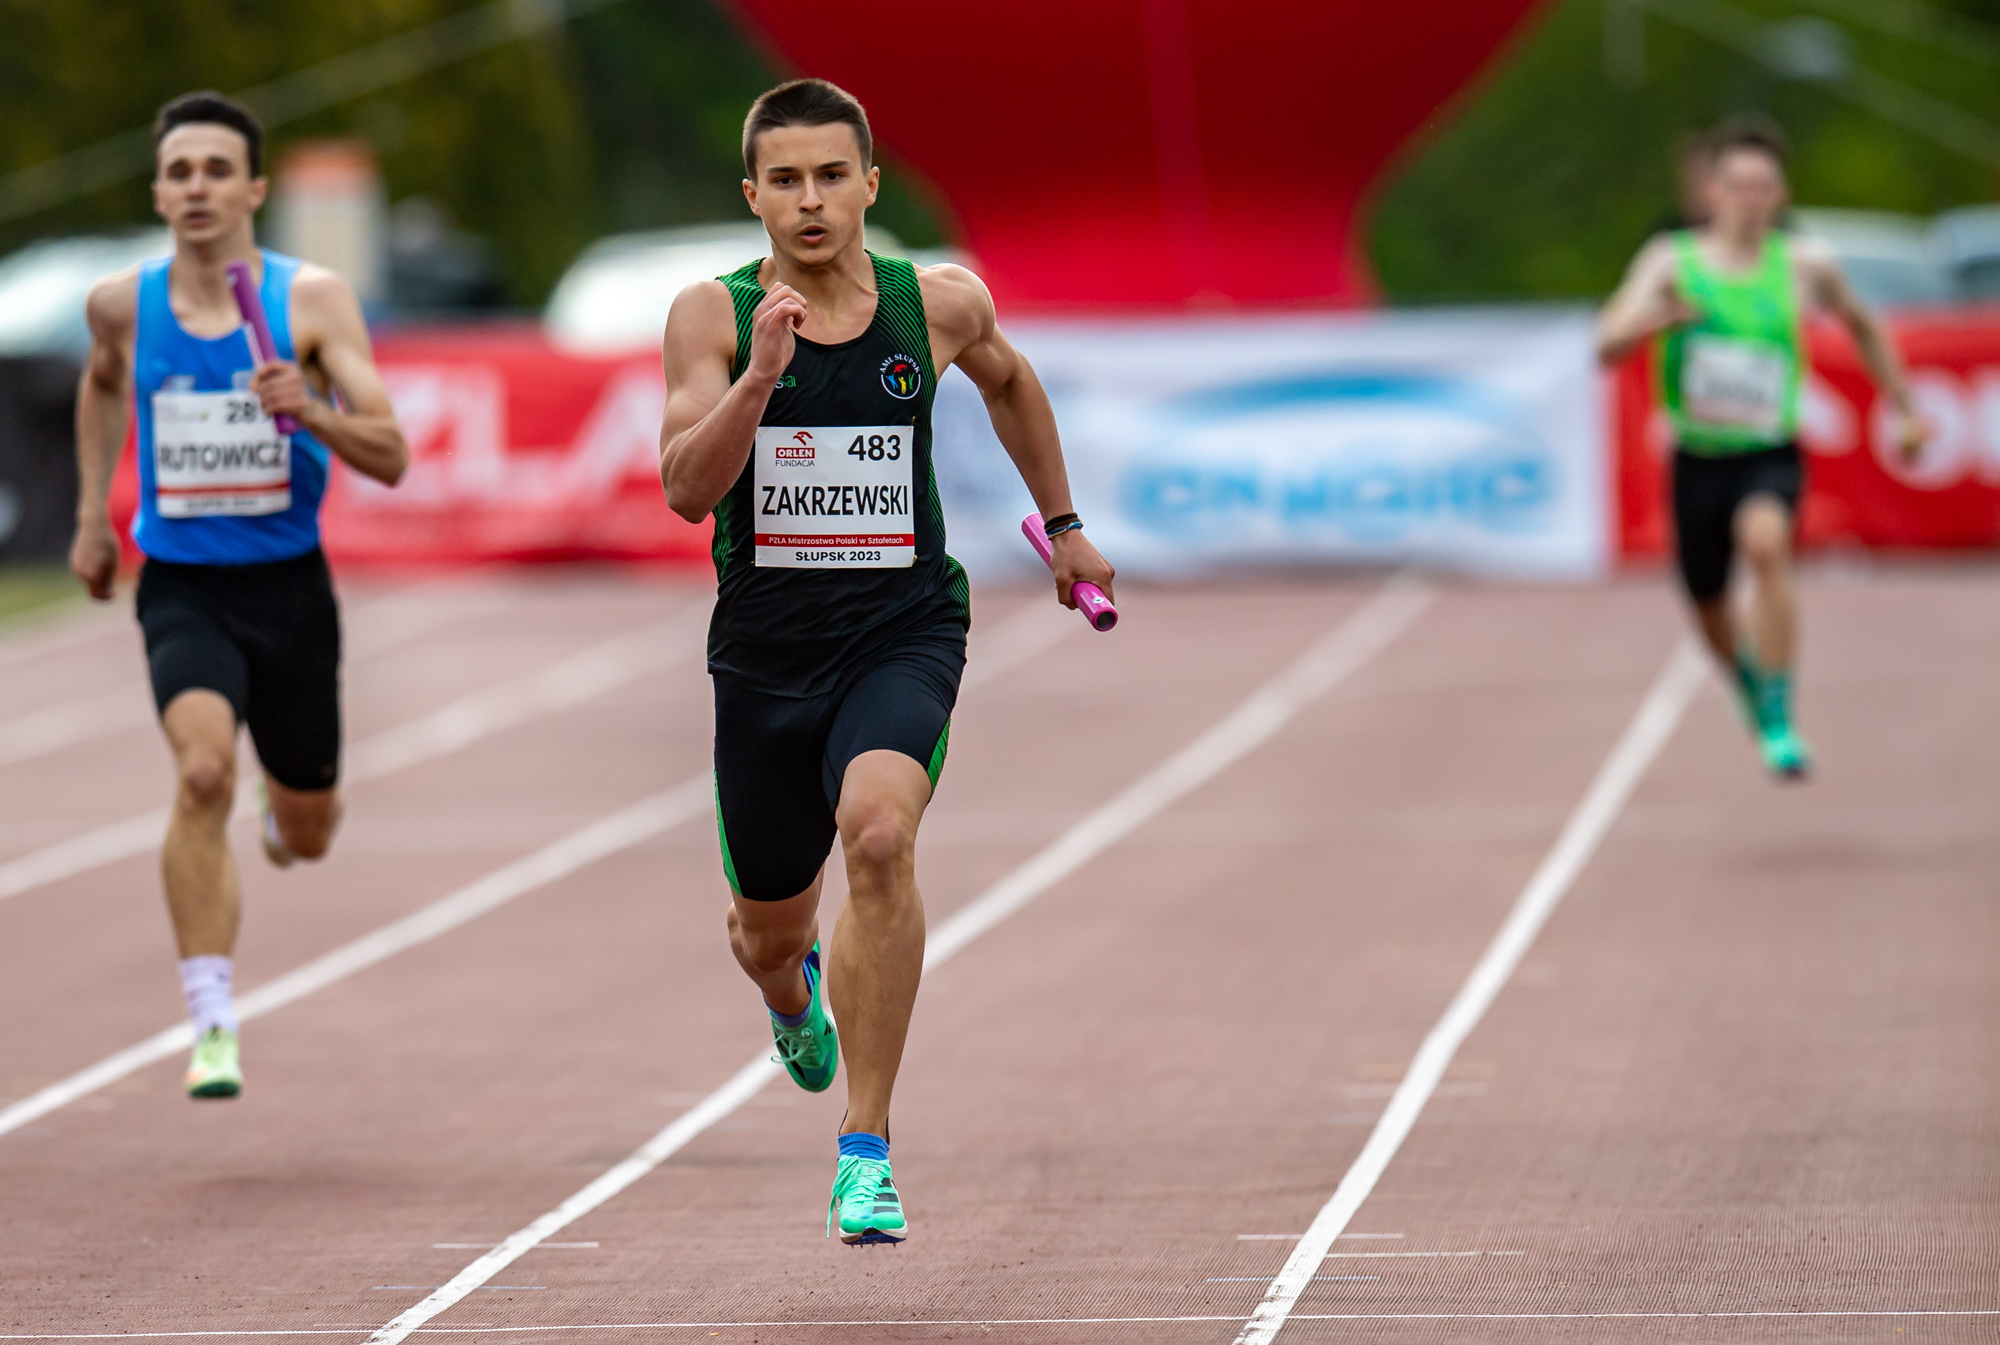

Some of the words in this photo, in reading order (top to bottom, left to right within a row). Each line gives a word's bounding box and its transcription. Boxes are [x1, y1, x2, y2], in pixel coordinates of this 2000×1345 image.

[227, 401, 271, 424] 28
[777, 448, 813, 458] ORLEN
[847, 434, 901, 462] 483
[775, 459, 815, 468] FUNDACJA
[761, 485, 908, 516] ZAKRZEWSKI
[768, 536, 787, 544] PZLA
[788, 536, 834, 545] Mistrzostwa
[835, 536, 858, 545] Polski
[867, 536, 904, 544] Sztafetach
[795, 551, 846, 562] SŁUPSK
[849, 551, 881, 561] 2023
